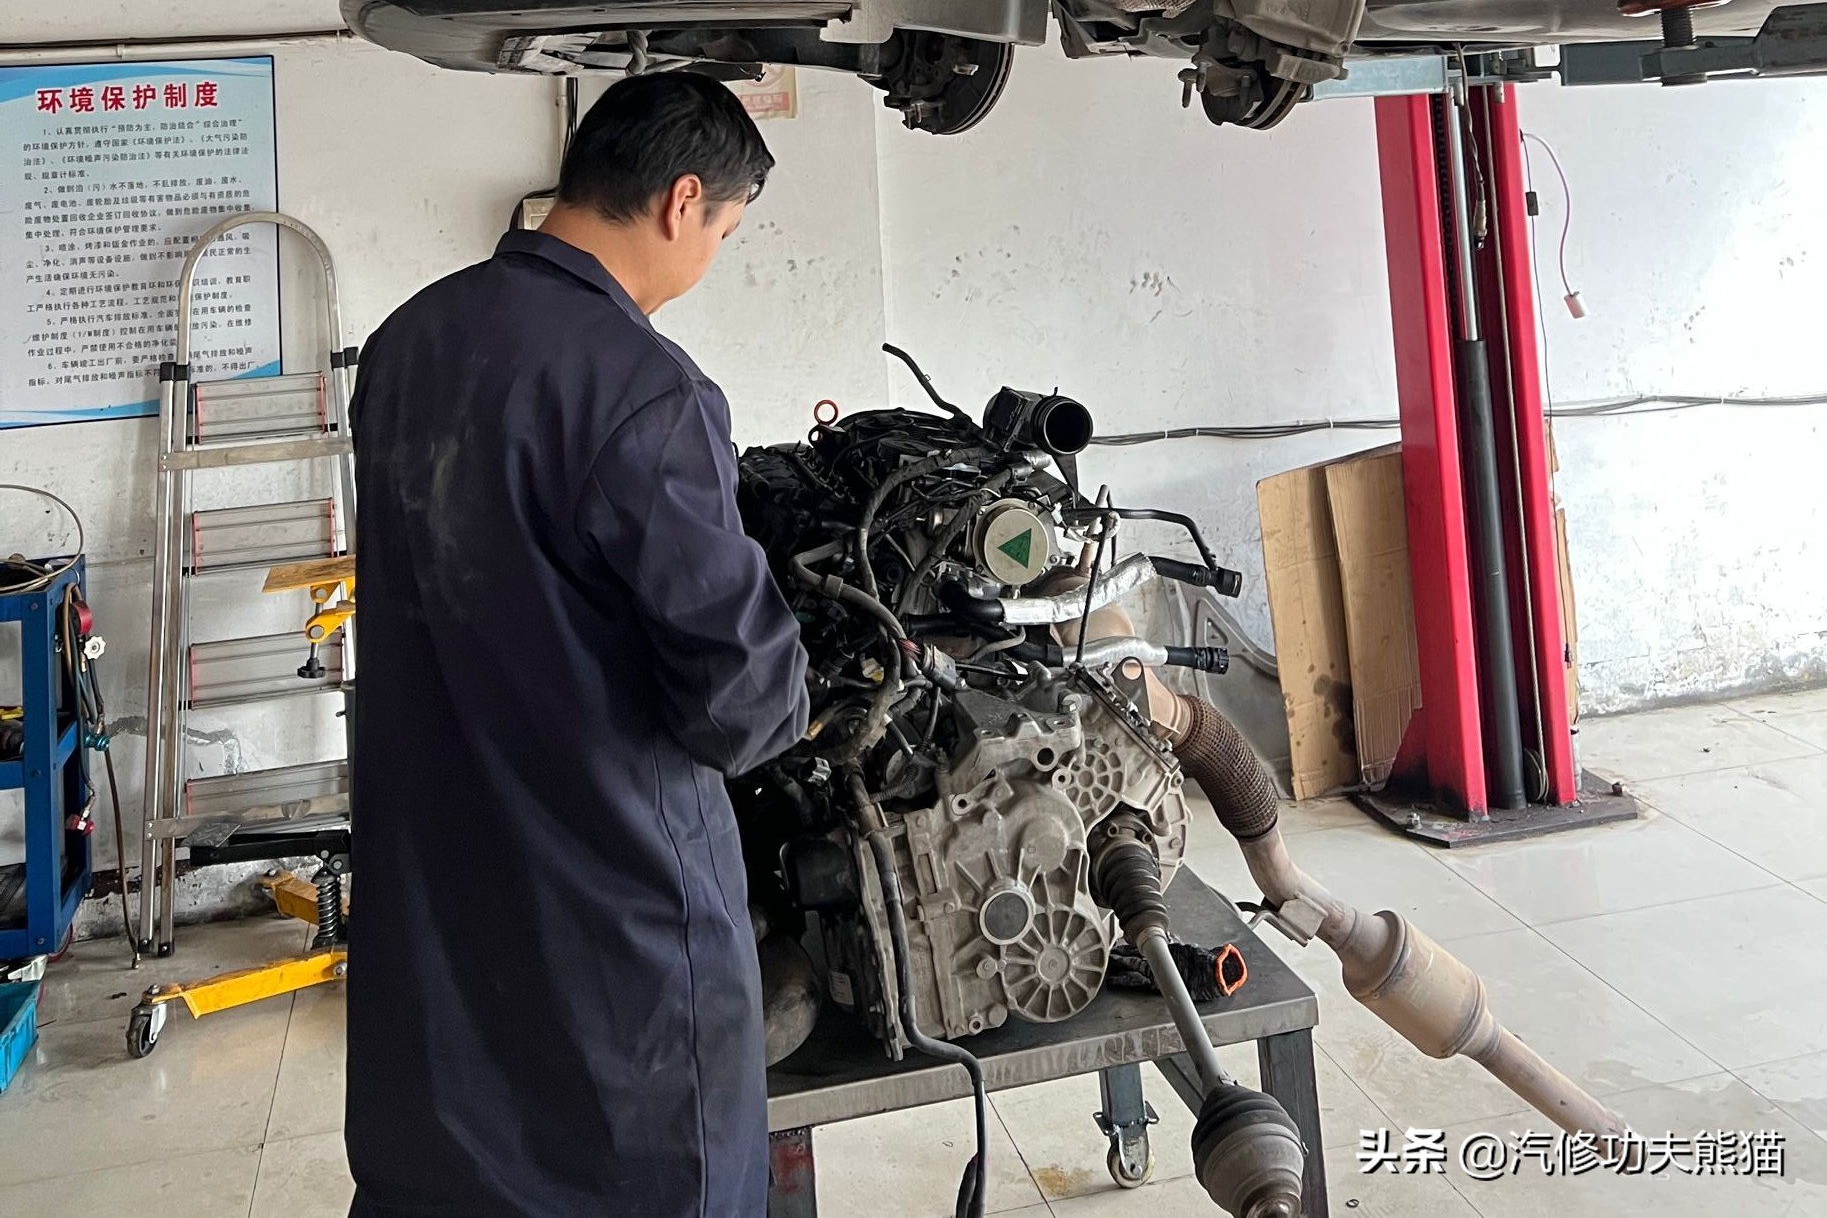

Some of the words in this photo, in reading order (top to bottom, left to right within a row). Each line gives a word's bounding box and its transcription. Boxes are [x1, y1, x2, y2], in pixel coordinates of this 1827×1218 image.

[37, 82, 218, 114] 环境保护制度
